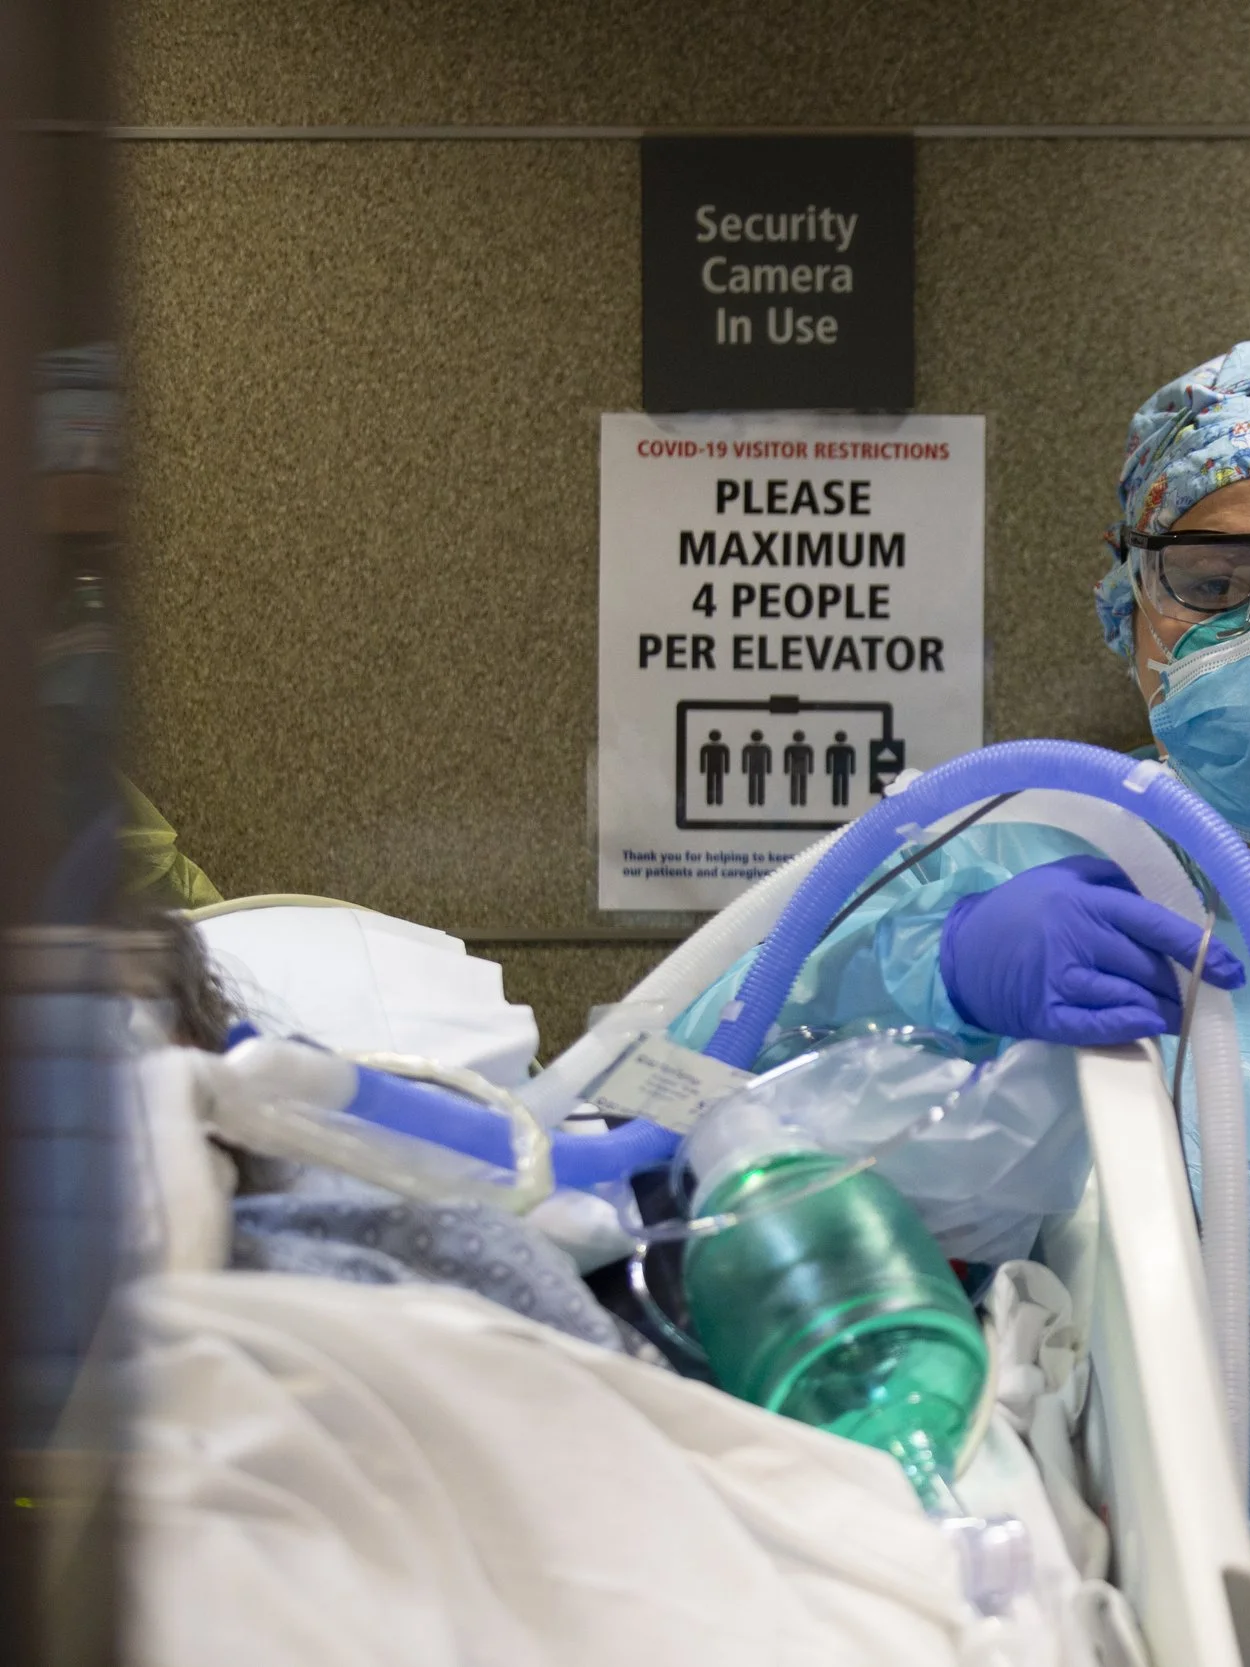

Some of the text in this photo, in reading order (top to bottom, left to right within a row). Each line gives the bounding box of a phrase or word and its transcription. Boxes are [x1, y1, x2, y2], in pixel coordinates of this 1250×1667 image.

[696, 204, 859, 253] Security
[702, 256, 854, 294] Camera
[715, 307, 839, 345] In Use
[637, 440, 951, 461] COVID-19 VISITOR RESTRICTIONS
[716, 479, 872, 516] PLEASE
[679, 530, 906, 568] MAXIMUM
[692, 583, 891, 619] 4 PEOPLE
[638, 634, 945, 672] PER ELEVATOR
[622, 849, 657, 862] Thank
[660, 851, 682, 865] you
[685, 849, 702, 862] for
[706, 849, 749, 866] helping
[752, 851, 765, 862] to
[623, 865, 776, 881] our patients and caregive
